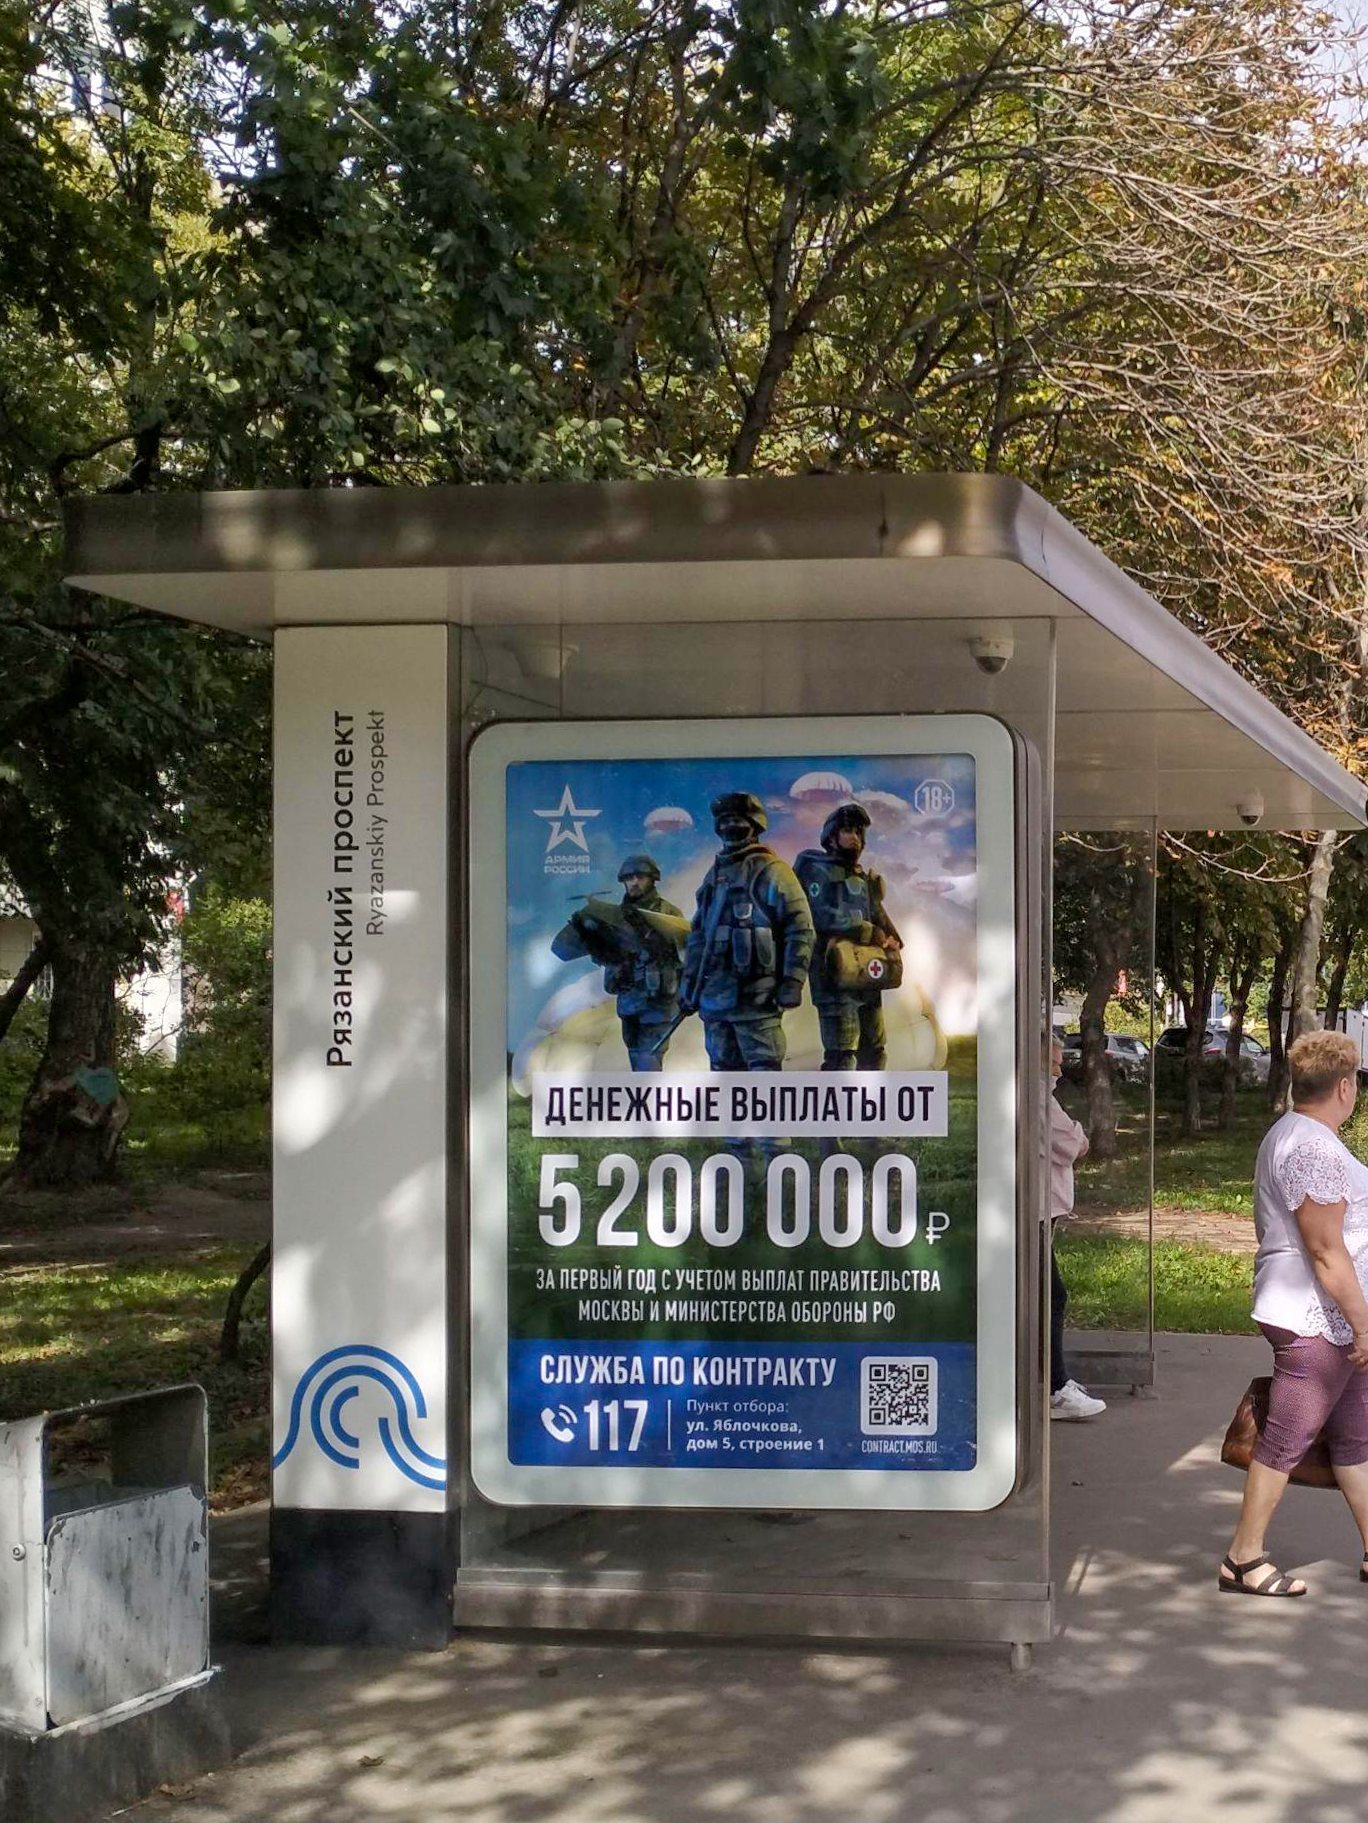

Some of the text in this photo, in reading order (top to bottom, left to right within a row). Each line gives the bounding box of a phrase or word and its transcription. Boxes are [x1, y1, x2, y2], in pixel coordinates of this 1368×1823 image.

[921, 786, 951, 811] 18+
[366, 709, 388, 936] Ryazanskiy Prospekt
[326, 710, 359, 1067] Рязанский проспект
[545, 1086, 935, 1126] ДЕНЕЖНЫЕ ВЫПЛАТЫ ОТ
[538, 1154, 582, 1247] 5
[596, 1153, 744, 1248] 200
[766, 1153, 918, 1248] 000
[536, 1265, 942, 1294] ЗА ПЕРВЫЙ ГОД С УЧЕТОМ ВЫПЛАТ ПРАВИТЕЛЬСТВА
[578, 1299, 896, 1323] МОСКВЫ И МИНИСТЕРСТВА ОБОРОНЫ РФ
[540, 1355, 837, 1387] СЛУЖБА ПО КОНТРАКТУ
[687, 1399, 789, 1414] Пункт отбора:
[583, 1399, 649, 1452] 117
[686, 1419, 803, 1434] ул. Яблочкова,
[686, 1438, 824, 1452] дом 5, строение 1
[861, 1439, 938, 1453] CONTRACT.MOS.RU
